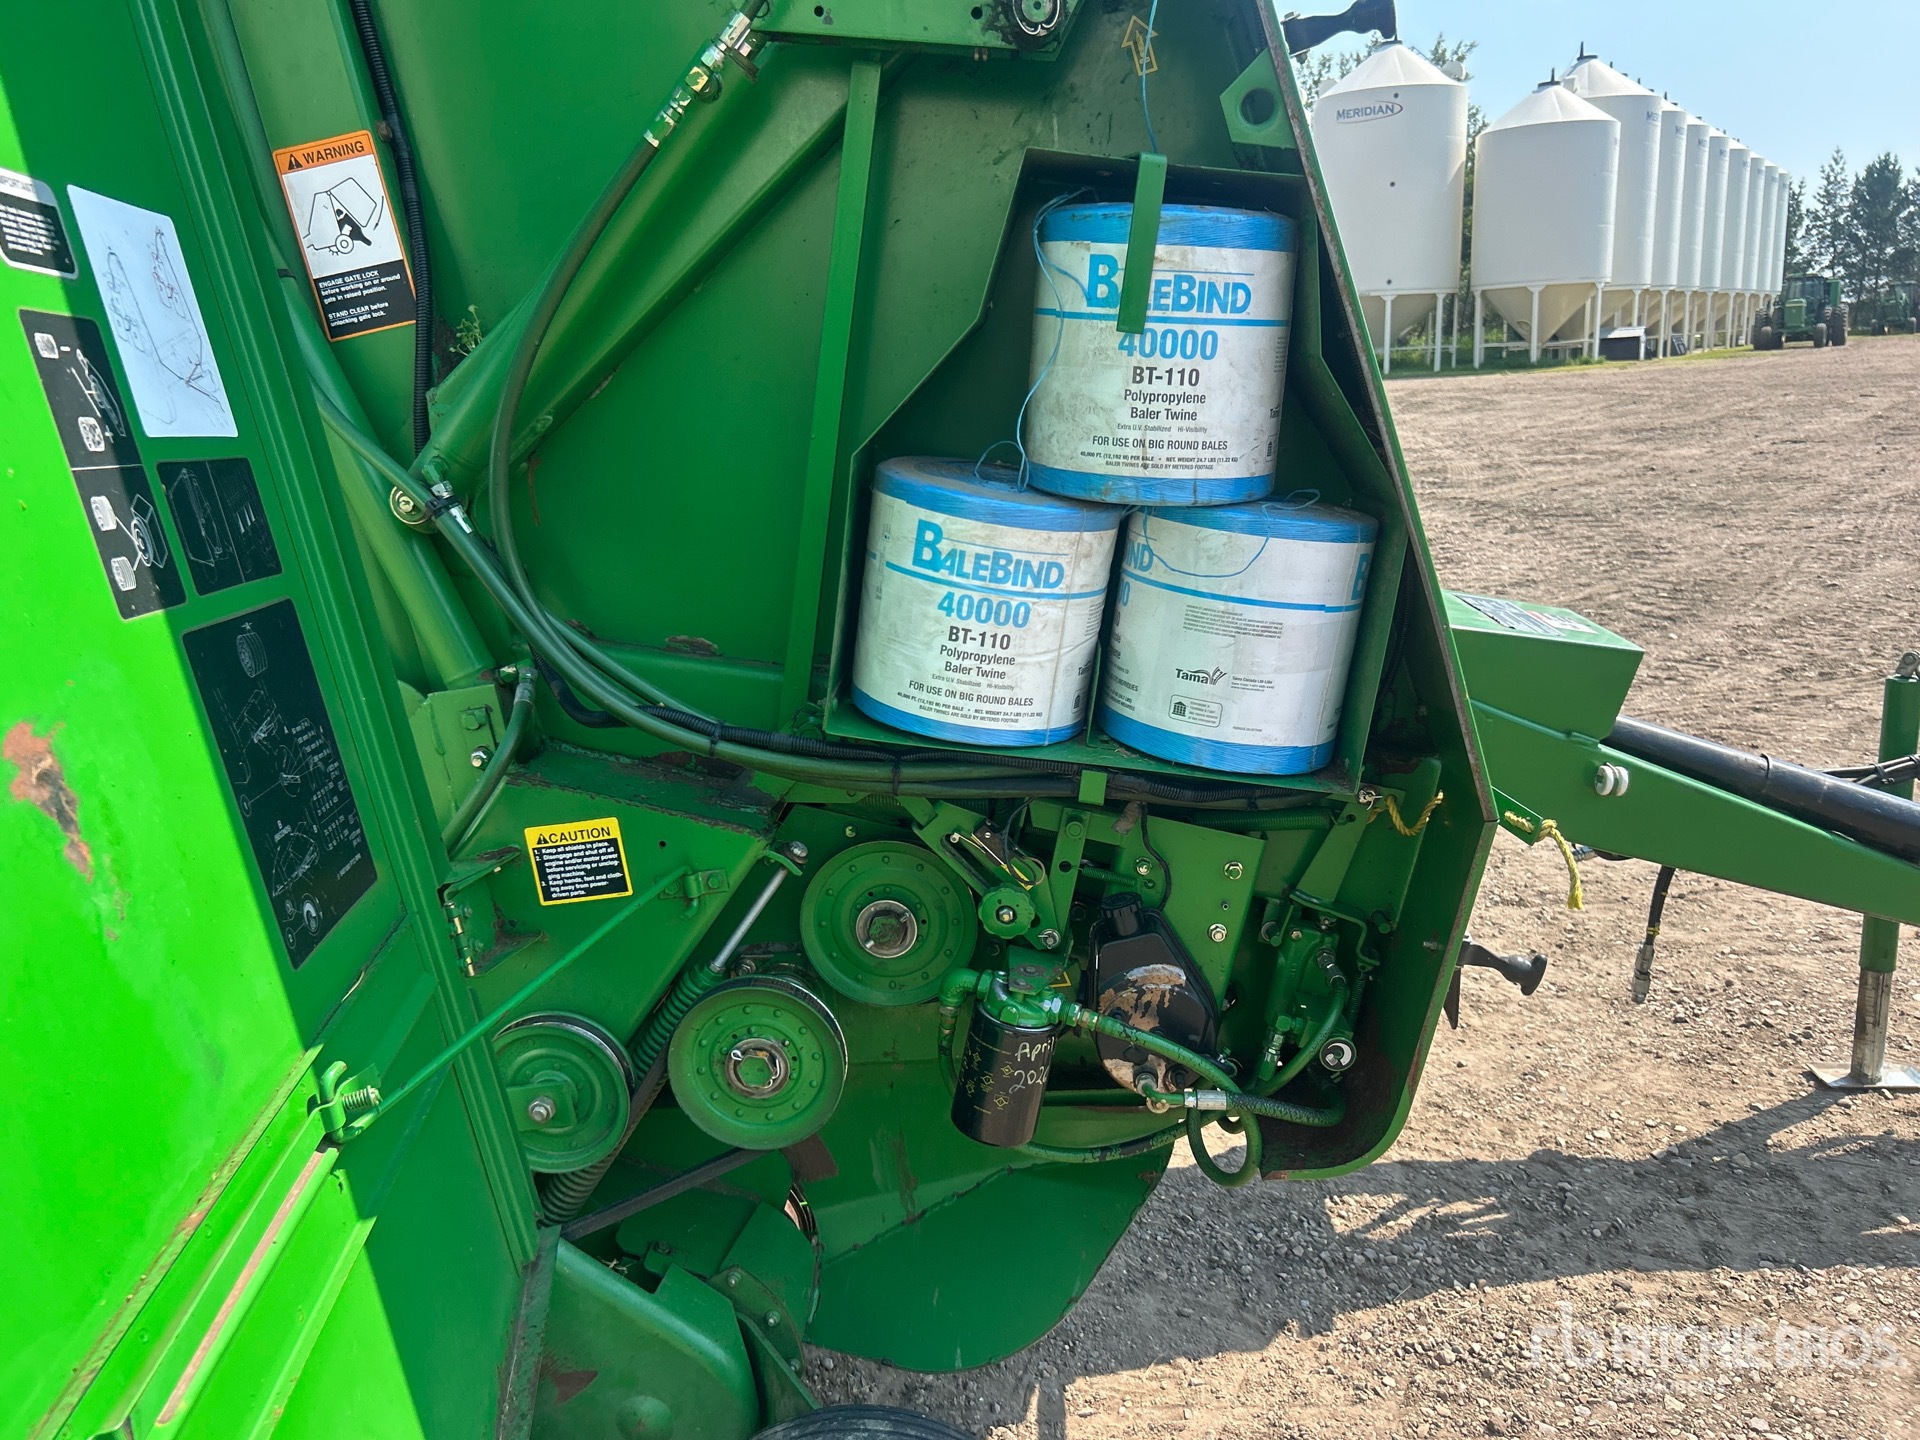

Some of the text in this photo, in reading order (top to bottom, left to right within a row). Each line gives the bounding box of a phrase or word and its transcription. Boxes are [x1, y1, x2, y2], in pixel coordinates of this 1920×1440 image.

[1336, 104, 1395, 121] MERIDIAN
[302, 140, 365, 165] WARNING
[318, 270, 380, 288] ENGAGE GATE LOCK
[321, 288, 340, 296] before
[341, 282, 363, 292] working
[380, 274, 400, 282] around
[1087, 253, 1252, 314] BEBIND
[344, 290, 362, 299] raised
[362, 285, 387, 296] position.
[328, 302, 389, 320] STAND CLEAR before
[330, 316, 358, 327] unlocking
[358, 314, 372, 322] gate
[1118, 328, 1219, 361] 40000
[1132, 365, 1200, 387] BT-110
[1124, 388, 1206, 404] Polypropylene
[1130, 406, 1198, 421] Baler Twine
[1178, 426, 1208, 434] Hi-Visibility
[1092, 436, 1228, 450] FOR USE ON BIG ROUND BALES
[912, 518, 1065, 590] BALEBIND
[937, 592, 1032, 628] 40000
[948, 625, 1011, 650] BT-110
[940, 644, 1016, 666] Polypropylene
[944, 661, 1006, 680] Baler Twine
[1176, 668, 1208, 684] Tama
[908, 680, 1034, 706] FOR USE ON BIG ROUND BALES
[956, 678, 982, 688] Stabilized
[986, 682, 1015, 692] Hi-Visibility
[548, 826, 611, 844] CAUTION
[1014, 1036, 1055, 1062] April
